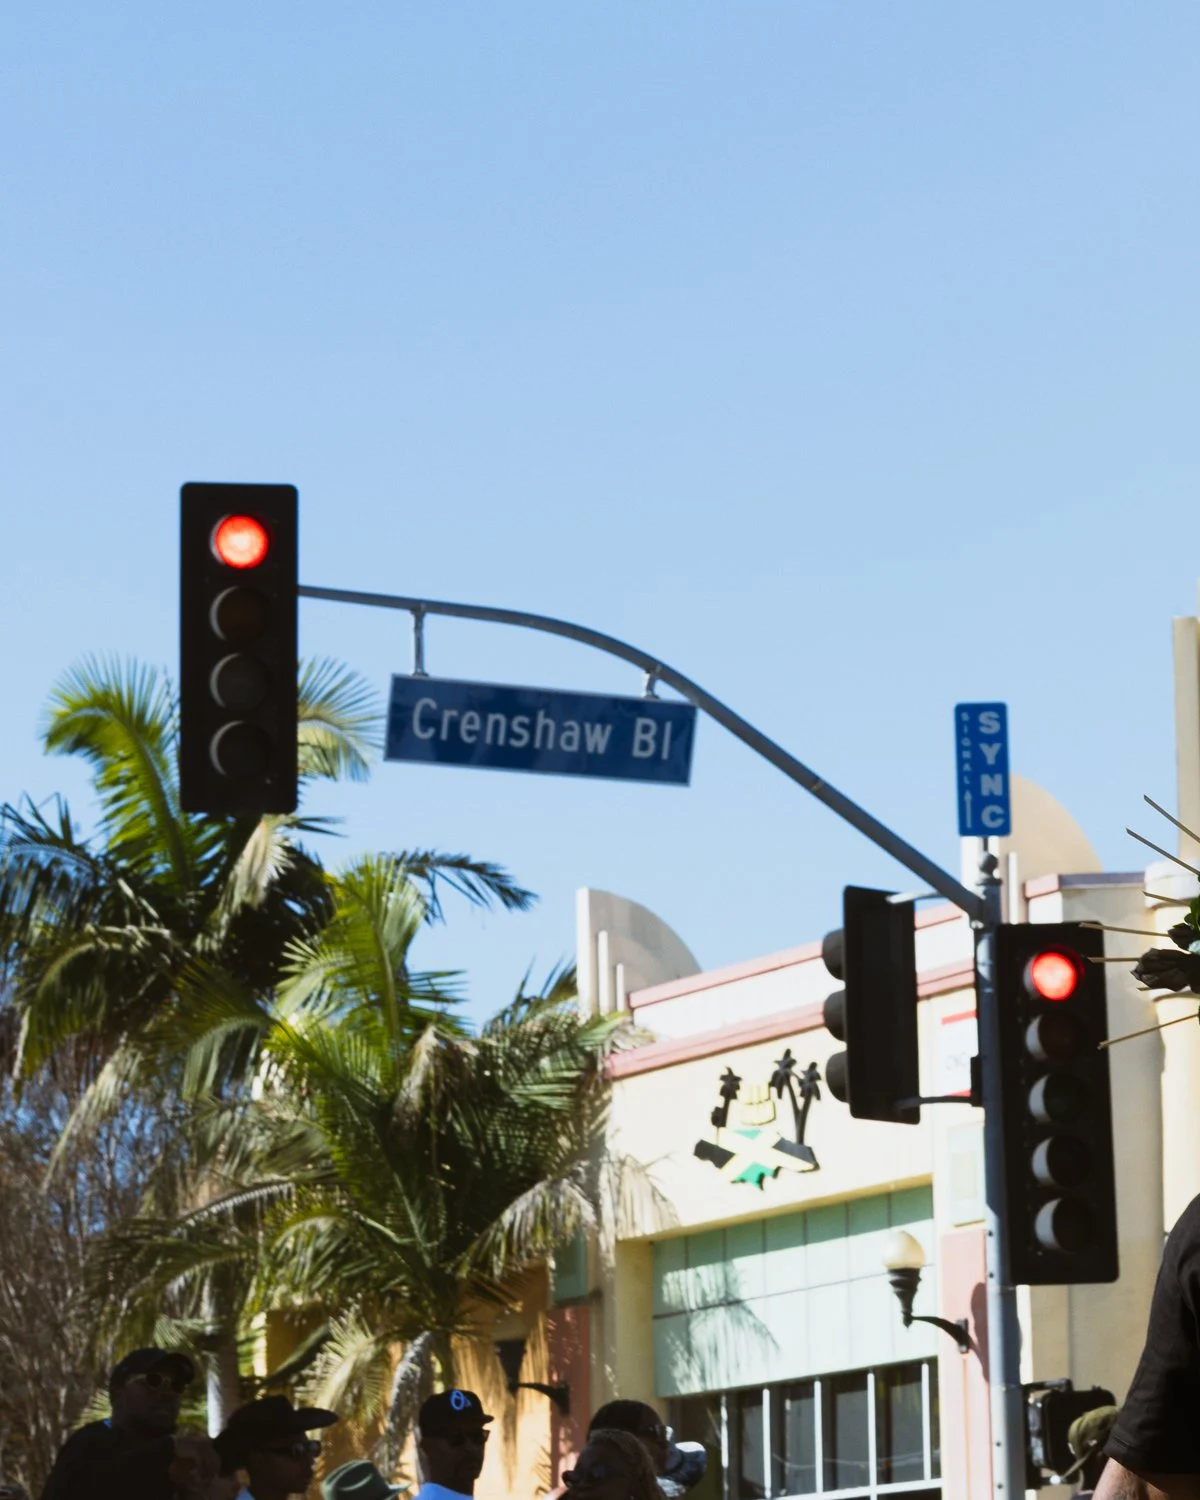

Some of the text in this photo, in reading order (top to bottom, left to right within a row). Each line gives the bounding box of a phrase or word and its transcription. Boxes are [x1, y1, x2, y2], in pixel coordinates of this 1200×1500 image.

[411, 696, 673, 761] Crenshaw Bl
[961, 711, 972, 785] SIGNAL
[978, 711, 1005, 829] SYNC
